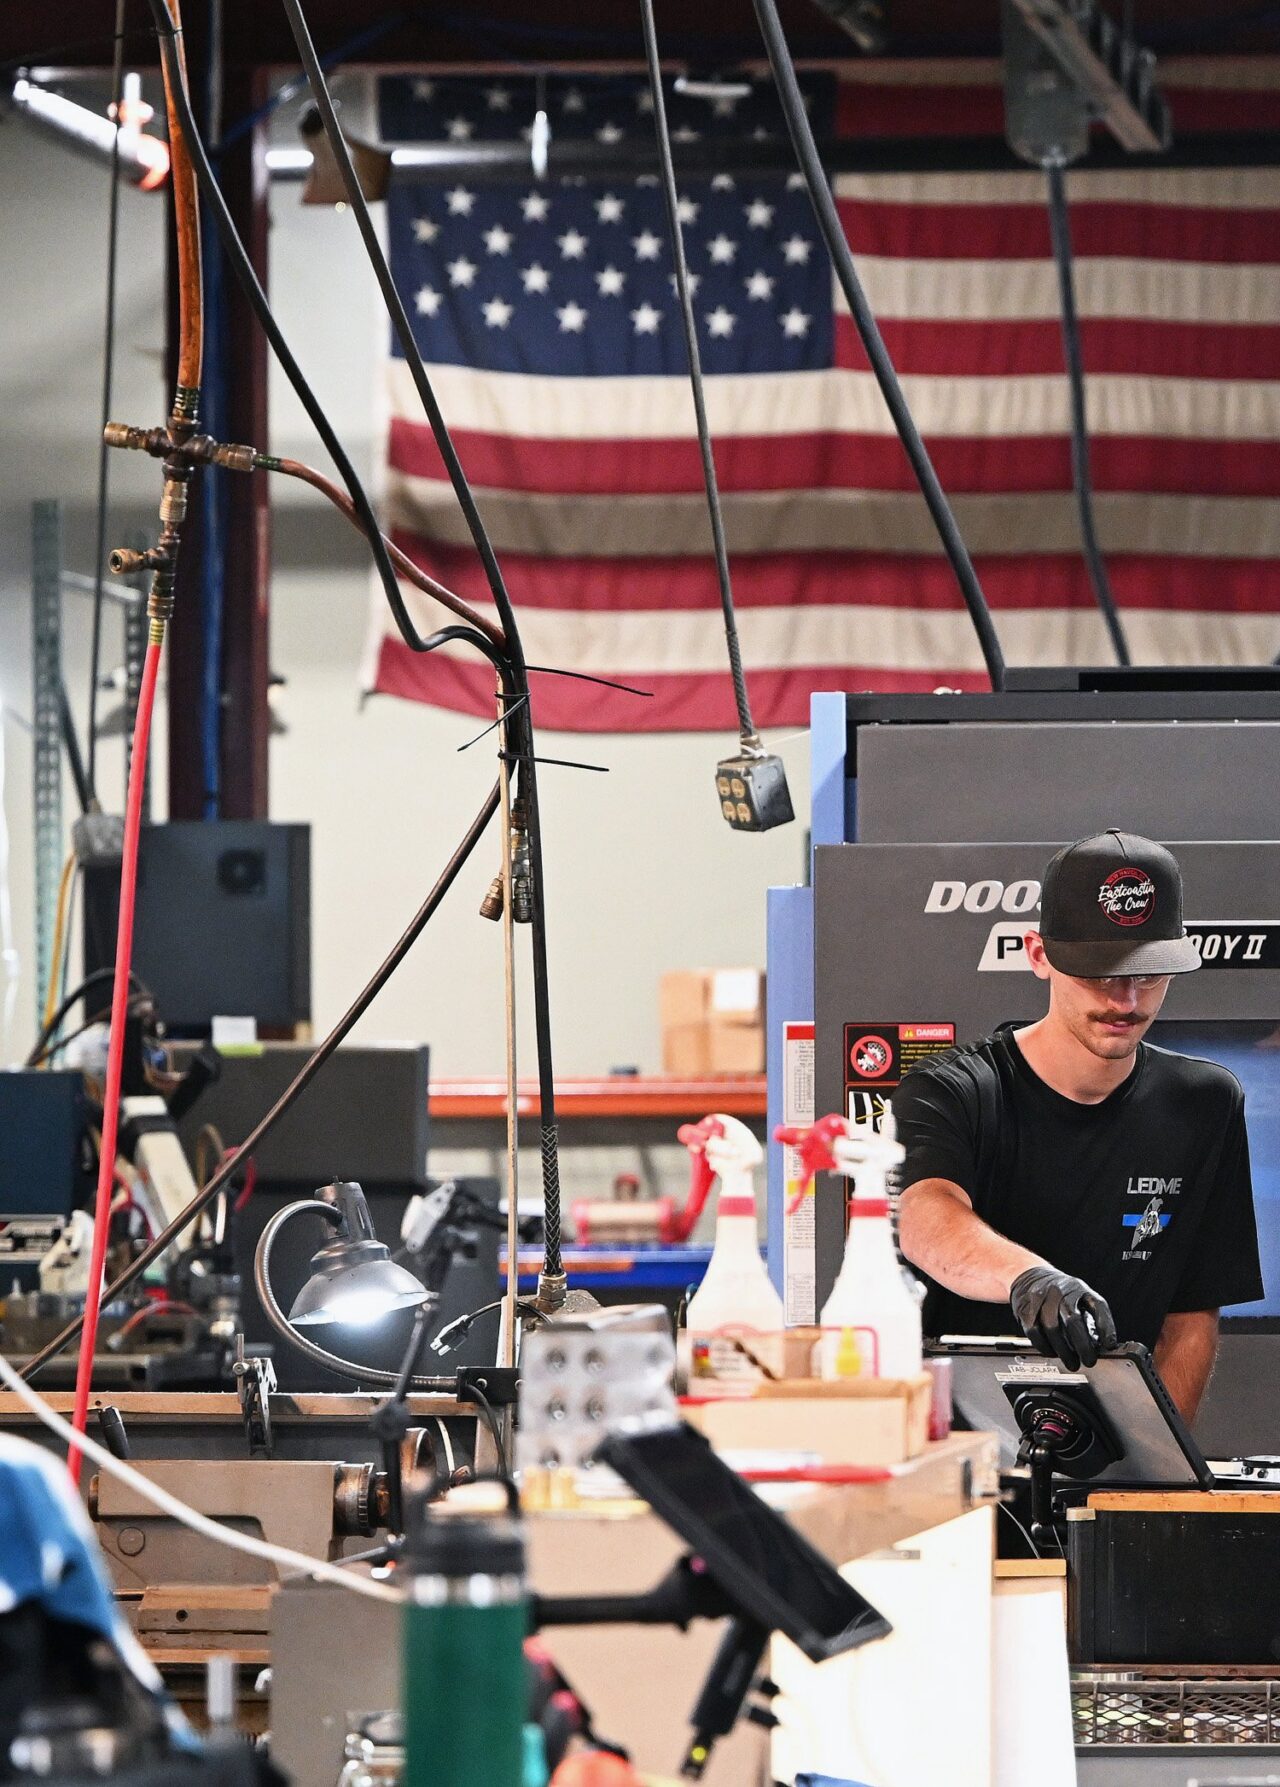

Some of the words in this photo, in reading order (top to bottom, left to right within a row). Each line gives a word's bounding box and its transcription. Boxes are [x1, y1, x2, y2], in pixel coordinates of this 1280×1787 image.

[924, 880, 1042, 913] DOO
[1103, 899, 1123, 914] The
[1125, 897, 1149, 912] Crew
